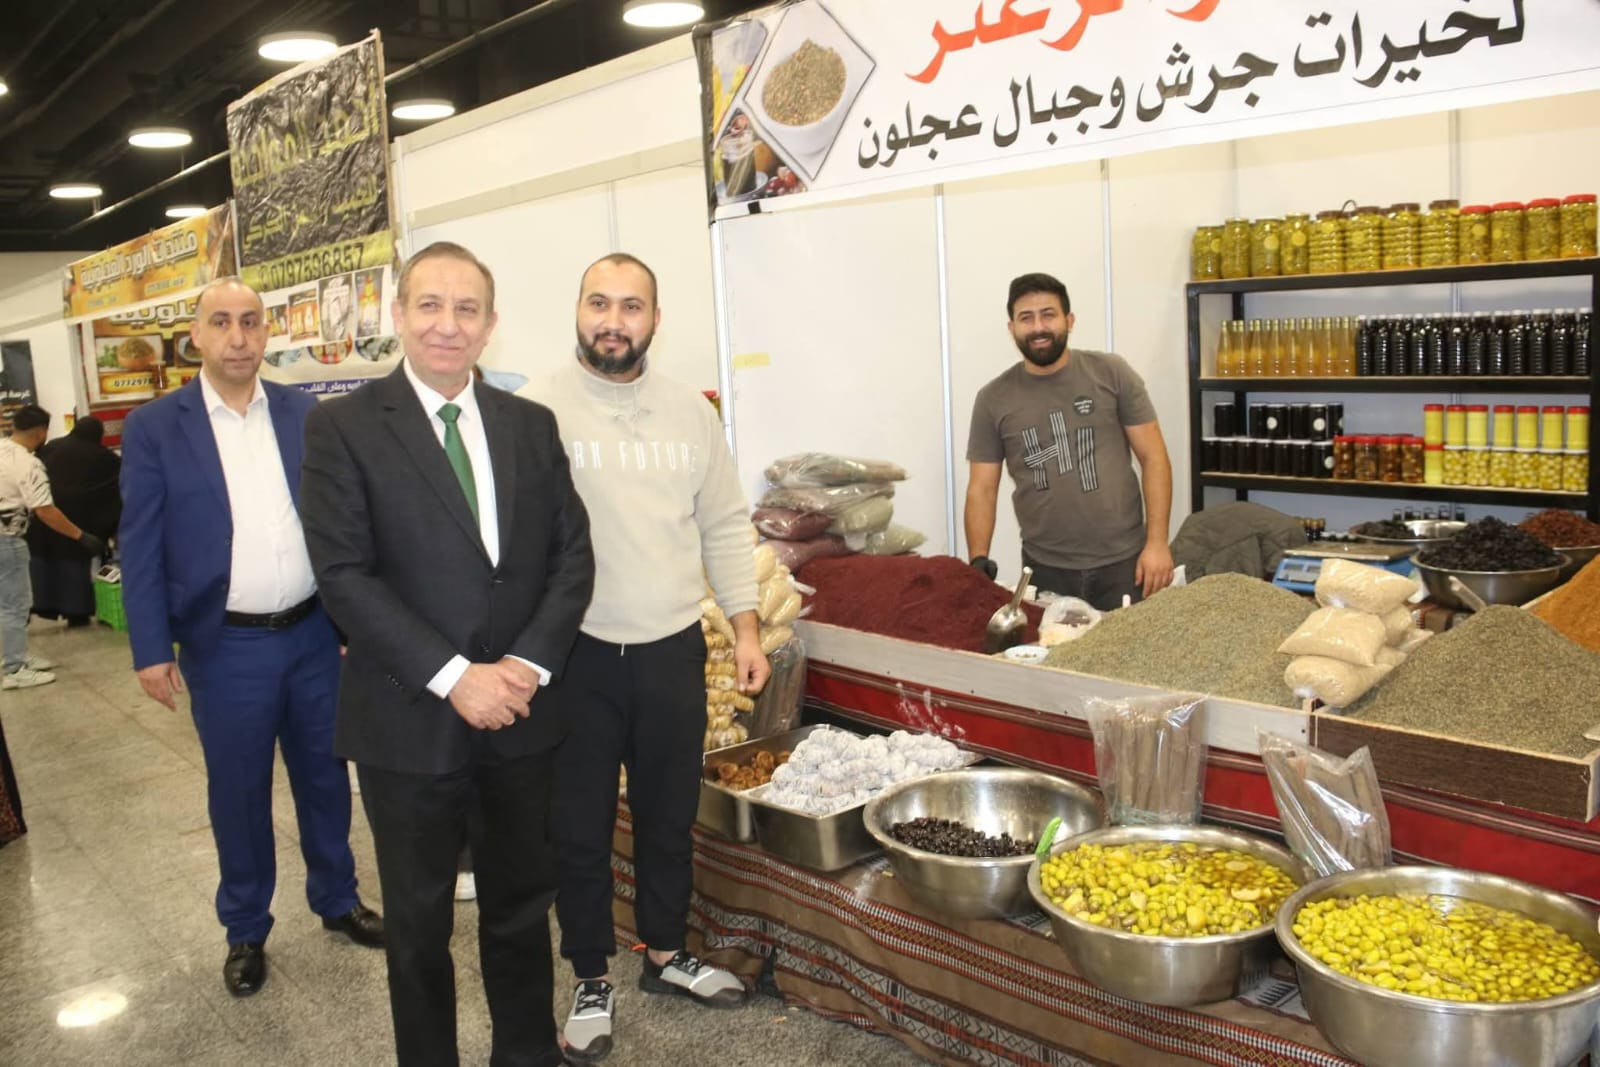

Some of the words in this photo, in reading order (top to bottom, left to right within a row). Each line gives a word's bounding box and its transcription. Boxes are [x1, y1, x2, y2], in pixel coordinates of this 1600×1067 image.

[993, 74, 1126, 148] وجبال
[1136, 42, 1279, 123] جرش
[858, 101, 983, 170] عجلون
[269, 242, 365, 289] 0797596857
